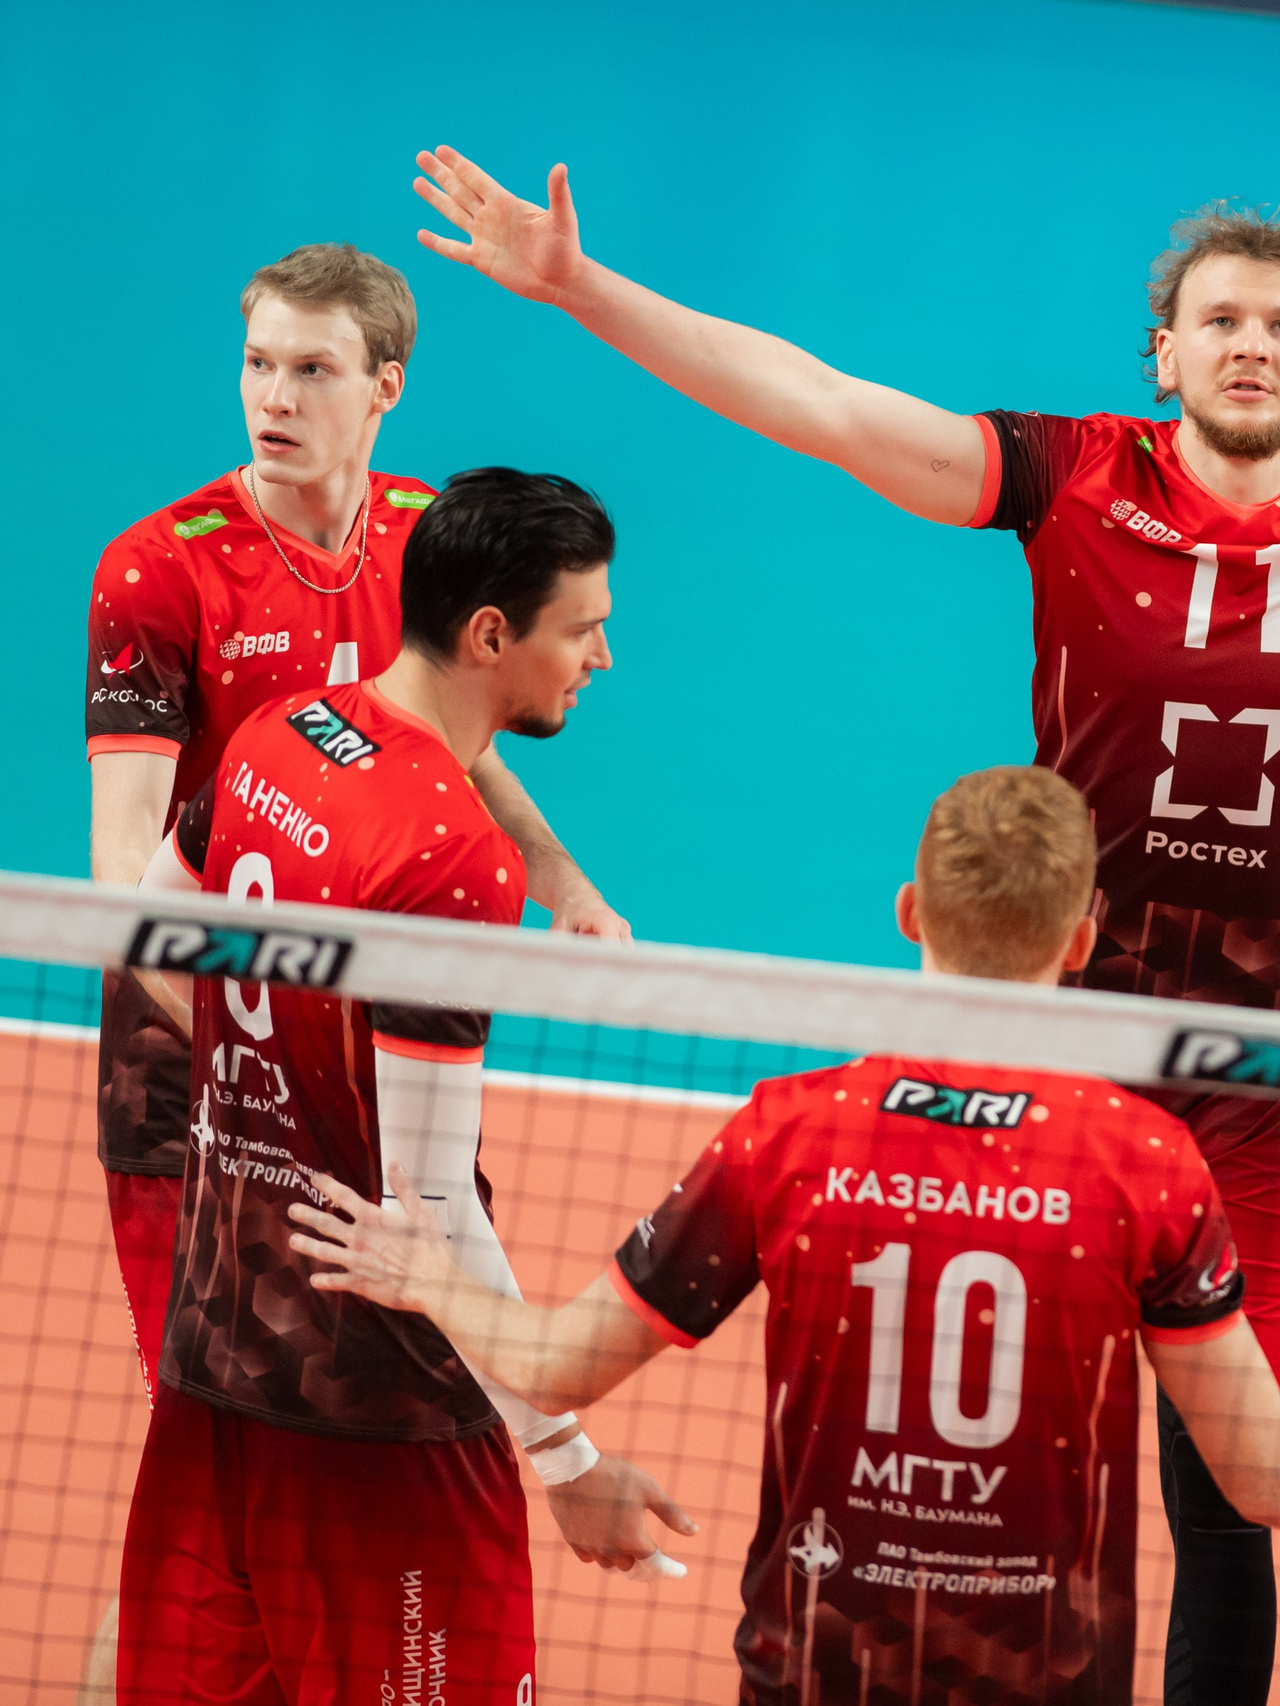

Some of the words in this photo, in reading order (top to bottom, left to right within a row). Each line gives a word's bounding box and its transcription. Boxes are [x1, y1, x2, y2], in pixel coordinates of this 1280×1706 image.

[242, 631, 290, 658] ВФВ
[290, 700, 374, 765] PARI
[1145, 830, 1268, 869] Ростех
[140, 922, 339, 987] PARI
[243, 1094, 296, 1131] БАУНА
[884, 1078, 1028, 1126] PARI
[826, 1166, 1071, 1225] КАЗБАНОВ
[851, 1241, 1027, 1449] 10
[851, 1446, 1008, 1505] МГТУ
[915, 1505, 1003, 1527] БАУМАНА
[877, 1542, 906, 1559] ПАО
